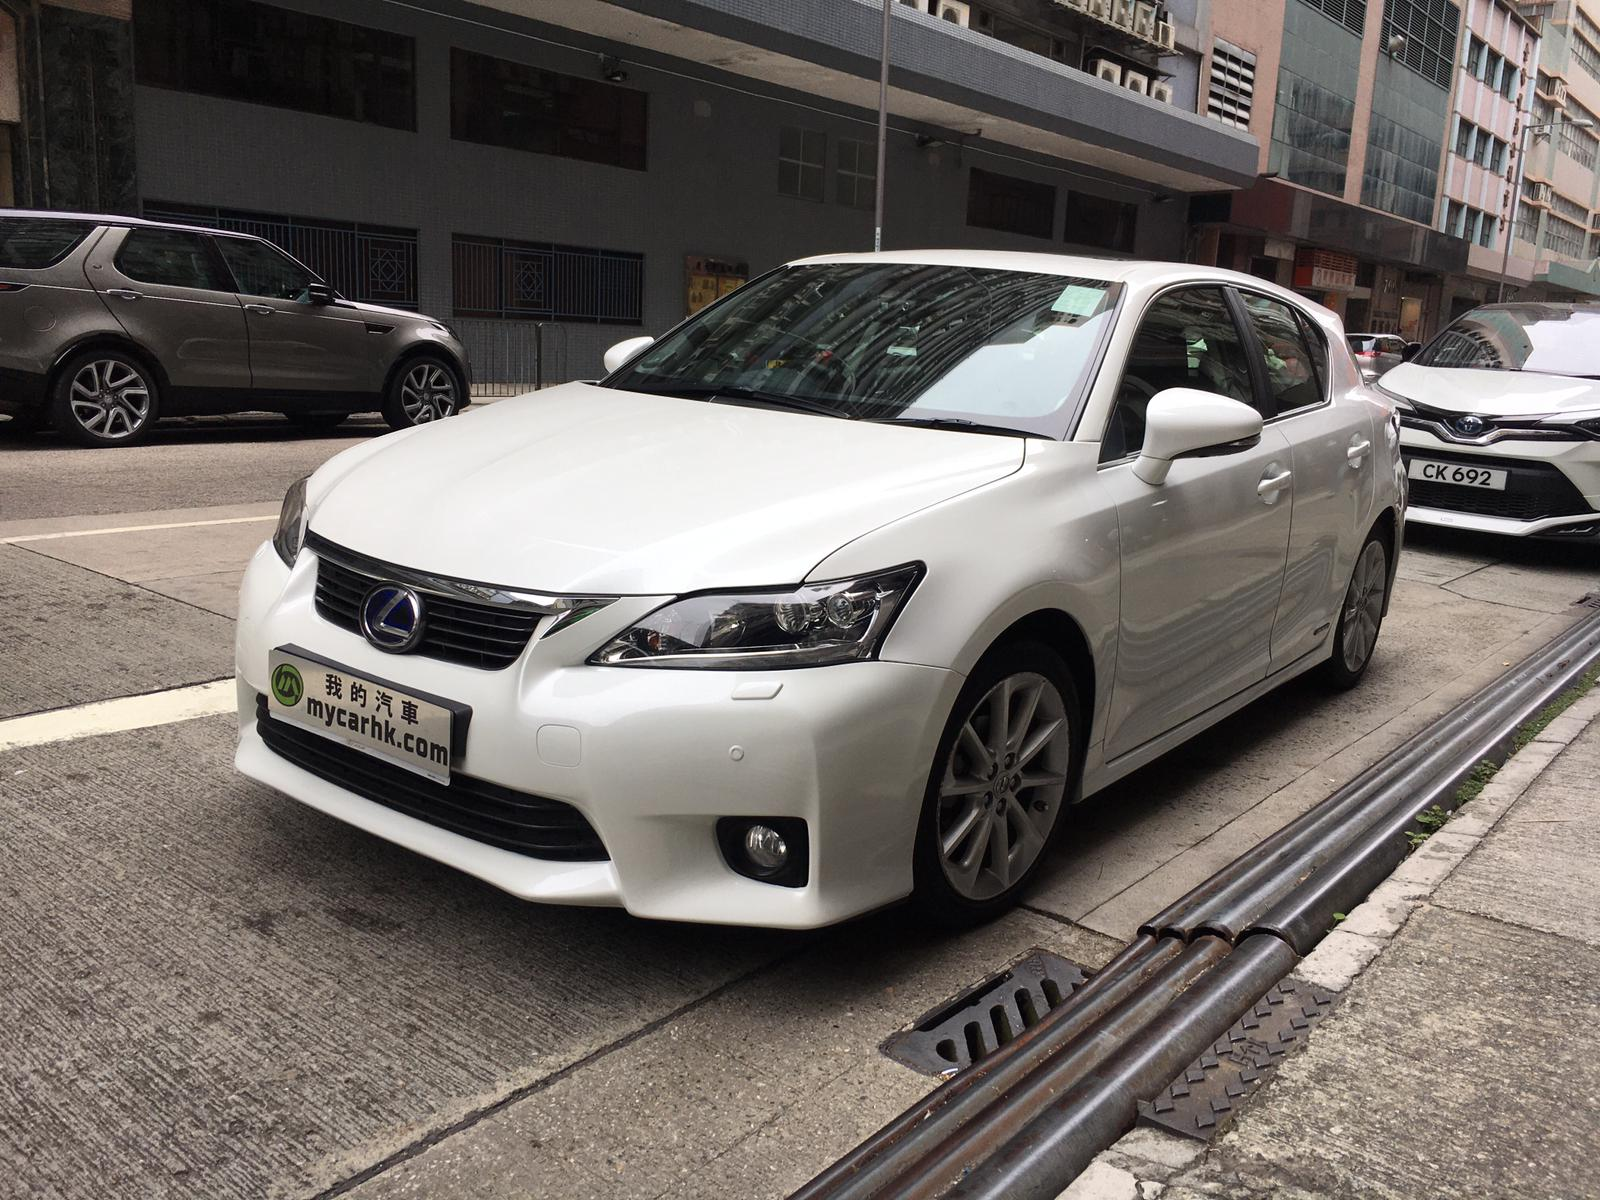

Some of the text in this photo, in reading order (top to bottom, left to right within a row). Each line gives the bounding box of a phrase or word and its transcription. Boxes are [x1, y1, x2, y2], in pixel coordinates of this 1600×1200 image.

[1423, 464, 1492, 486] CK 692
[325, 673, 419, 725] 我的汽車
[306, 696, 449, 766] mycarhk.com
